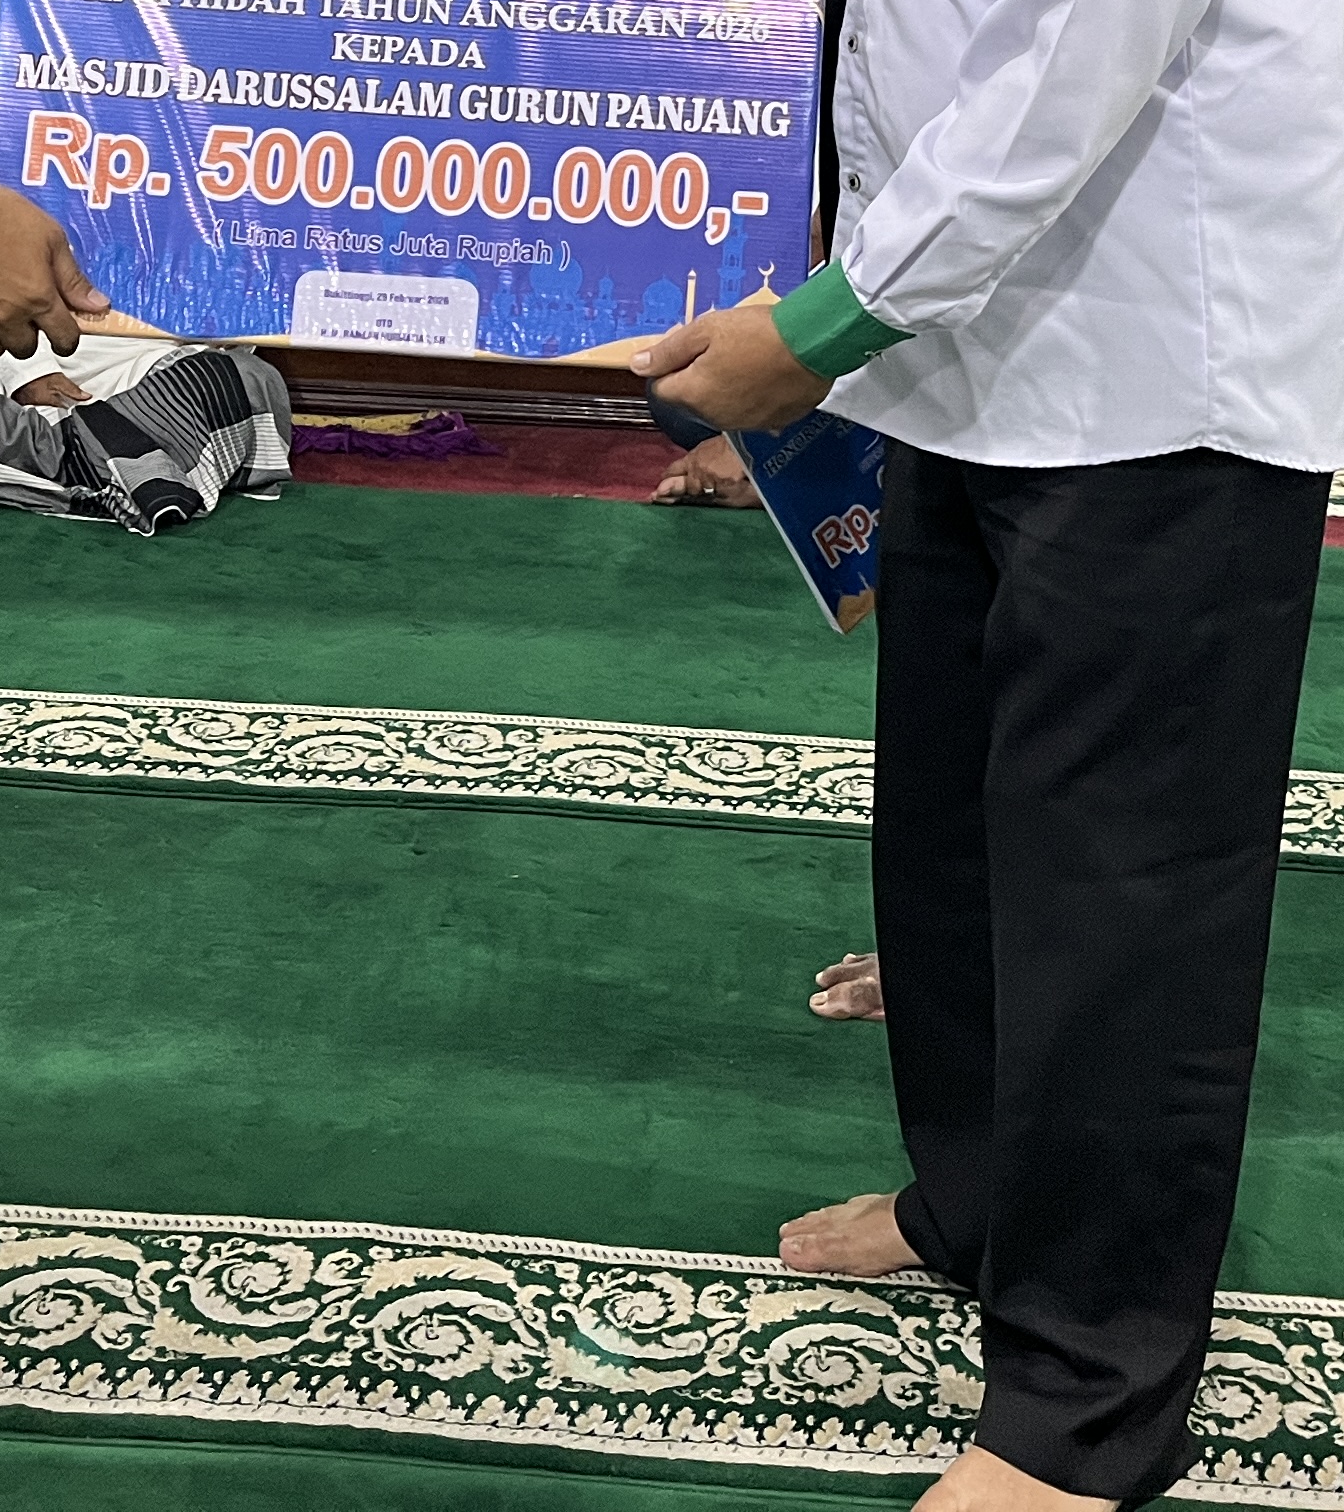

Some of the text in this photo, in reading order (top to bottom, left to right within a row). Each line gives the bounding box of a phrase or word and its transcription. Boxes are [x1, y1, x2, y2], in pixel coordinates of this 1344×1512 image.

[331, 32, 487, 70] KEPADA
[696, 13, 770, 44] 2026
[15, 52, 791, 137] MASJID DARUSSALAM GURUN PANJANG
[22, 110, 770, 245] Rp. 500.000.000,-
[230, 221, 297, 249] Lima
[304, 225, 383, 255] Ratus
[389, 232, 450, 259] Juta
[456, 234, 553, 267] Rupiah
